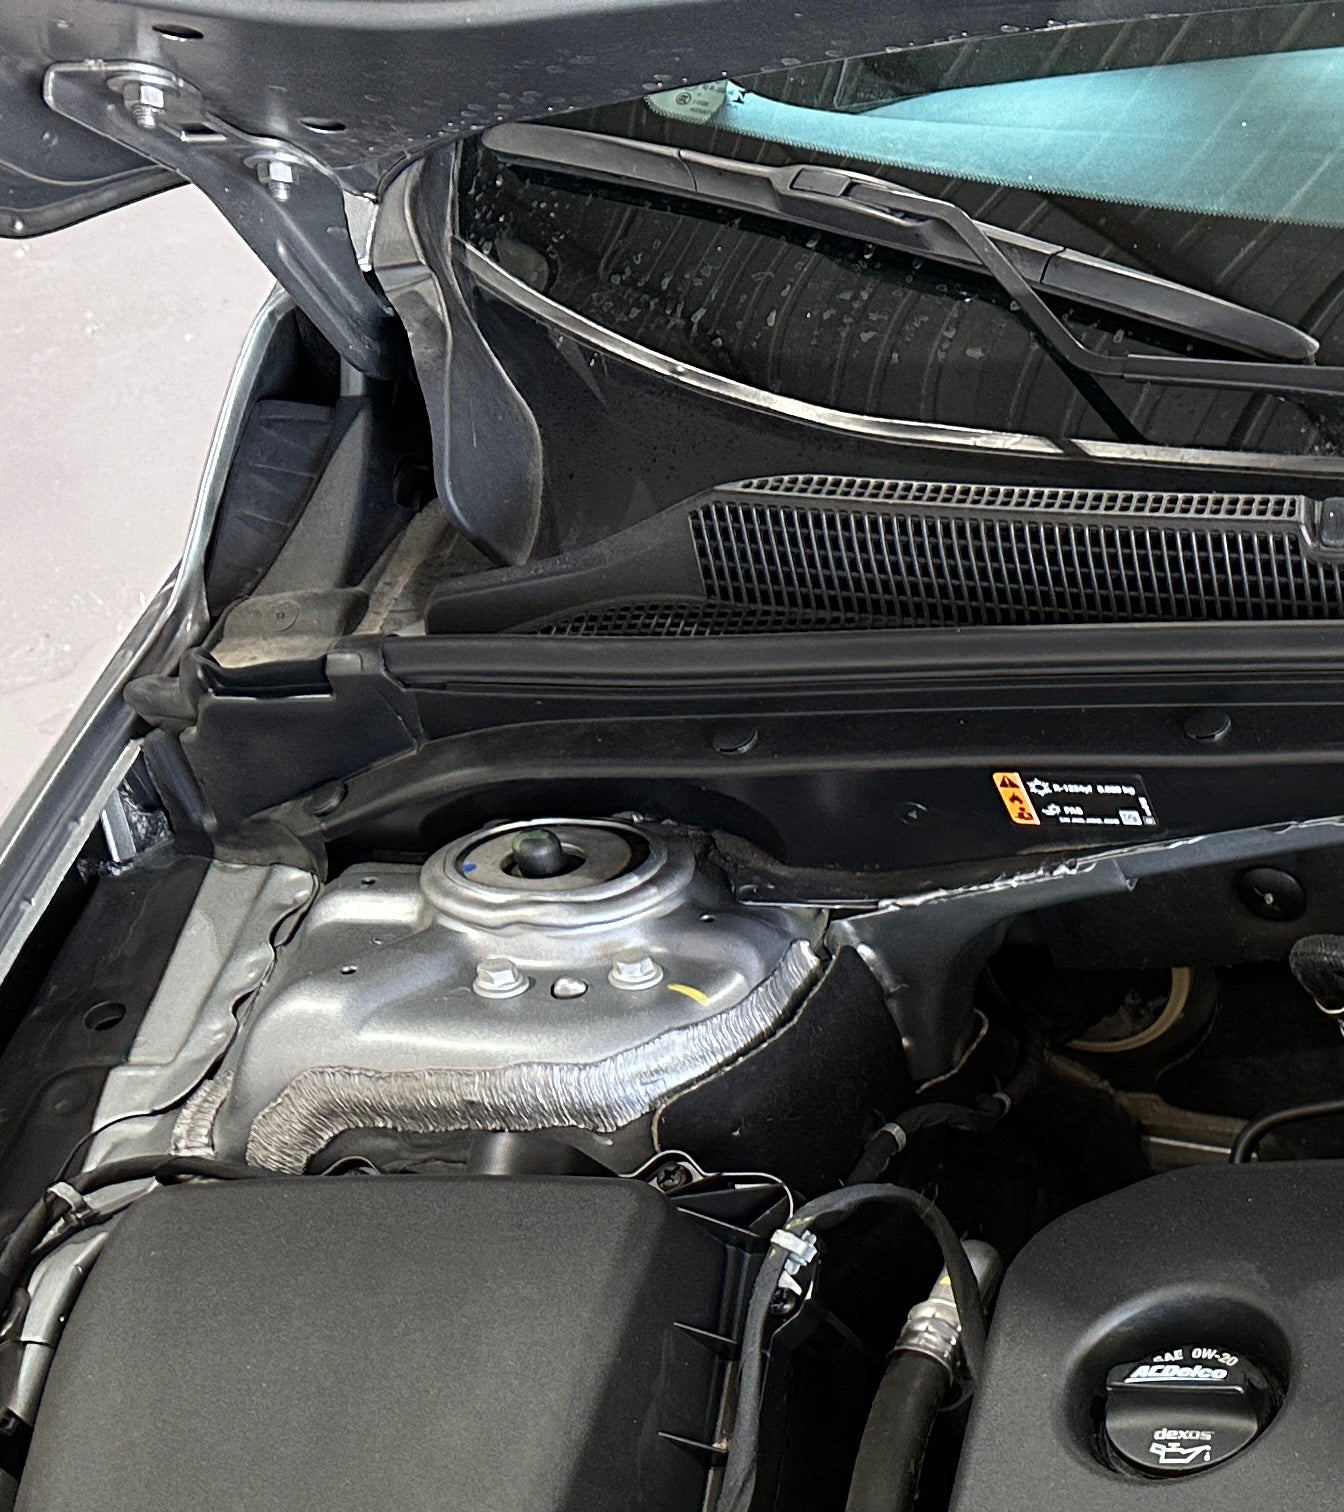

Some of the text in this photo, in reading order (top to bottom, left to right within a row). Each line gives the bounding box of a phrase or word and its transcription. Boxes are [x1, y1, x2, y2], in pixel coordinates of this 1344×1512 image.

[1191, 1347, 1239, 1367] 0W-20
[1129, 1364, 1228, 1380] ACDelco
[1153, 1427, 1213, 1441] dexos
